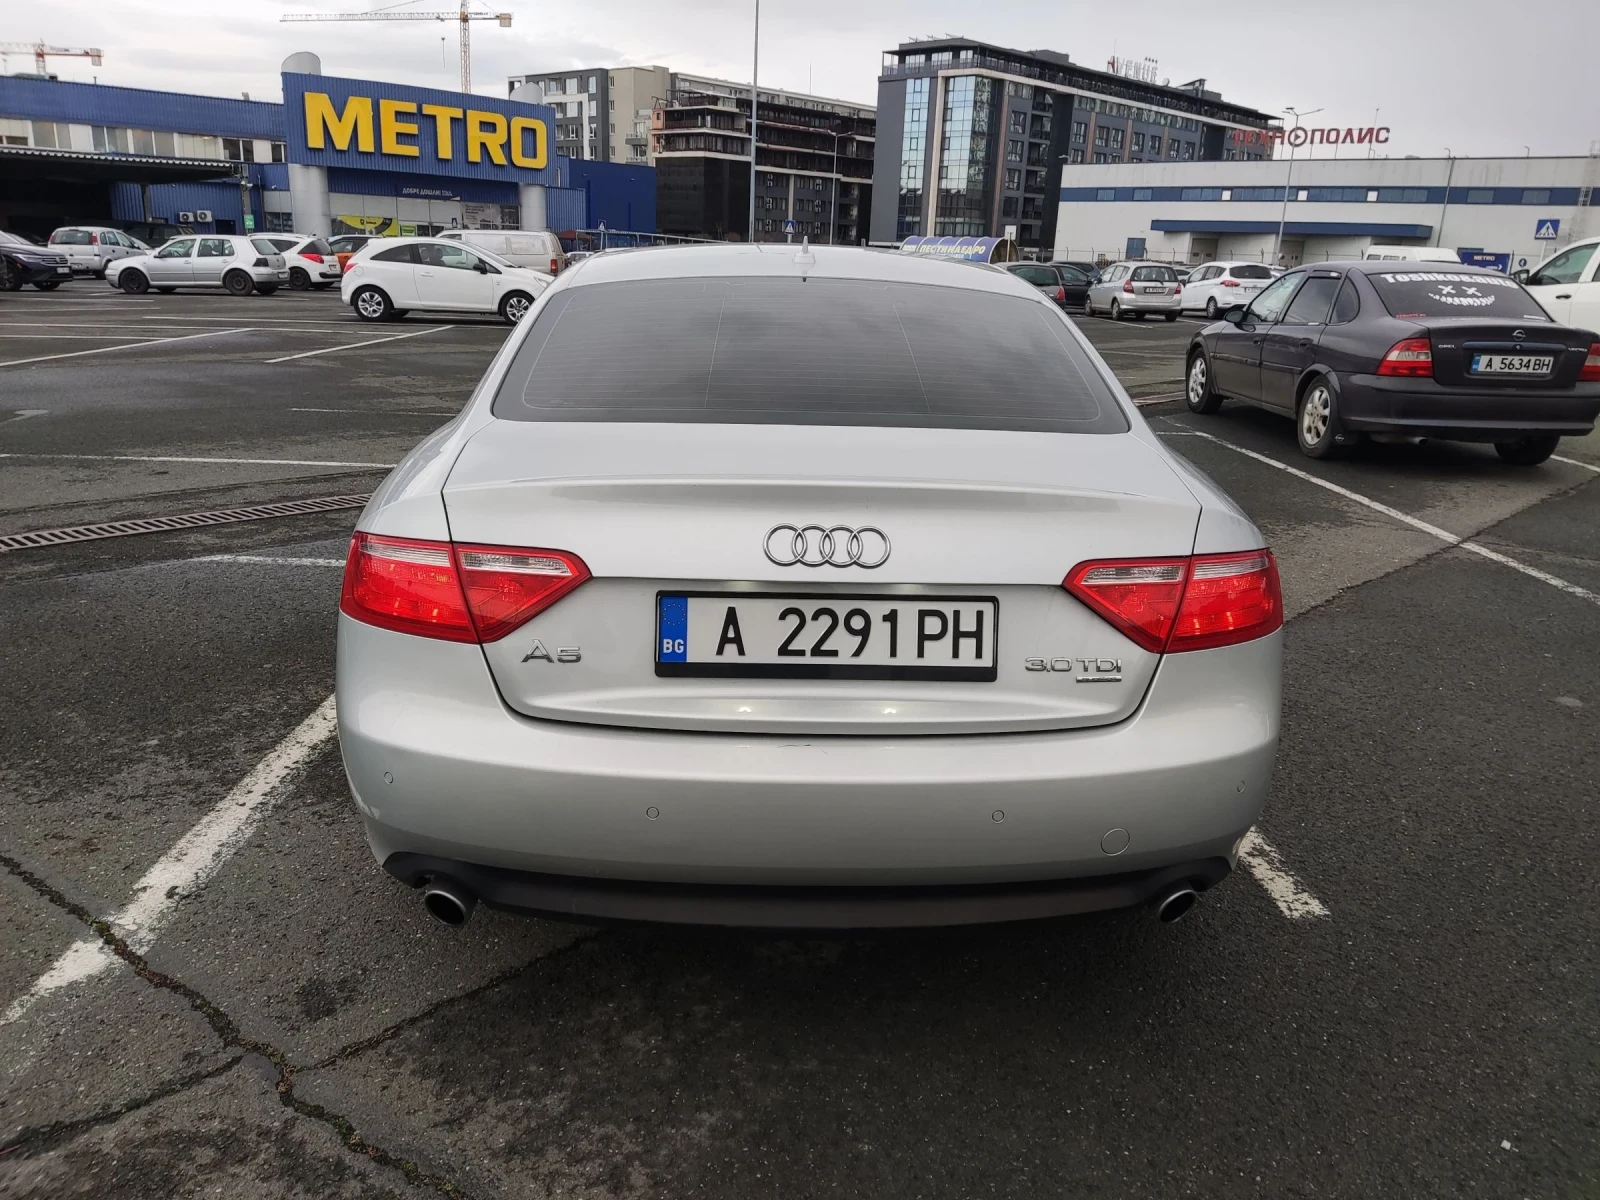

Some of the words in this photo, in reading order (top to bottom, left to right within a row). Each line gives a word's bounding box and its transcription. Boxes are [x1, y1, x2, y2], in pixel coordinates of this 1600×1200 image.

[304, 91, 548, 170] METRO
[1484, 357, 1493, 370] A
[715, 606, 746, 656] A
[521, 638, 582, 664] A5
[663, 639, 684, 653] BG
[1025, 657, 1072, 672] 3.0
[1076, 658, 1122, 673] TDI
